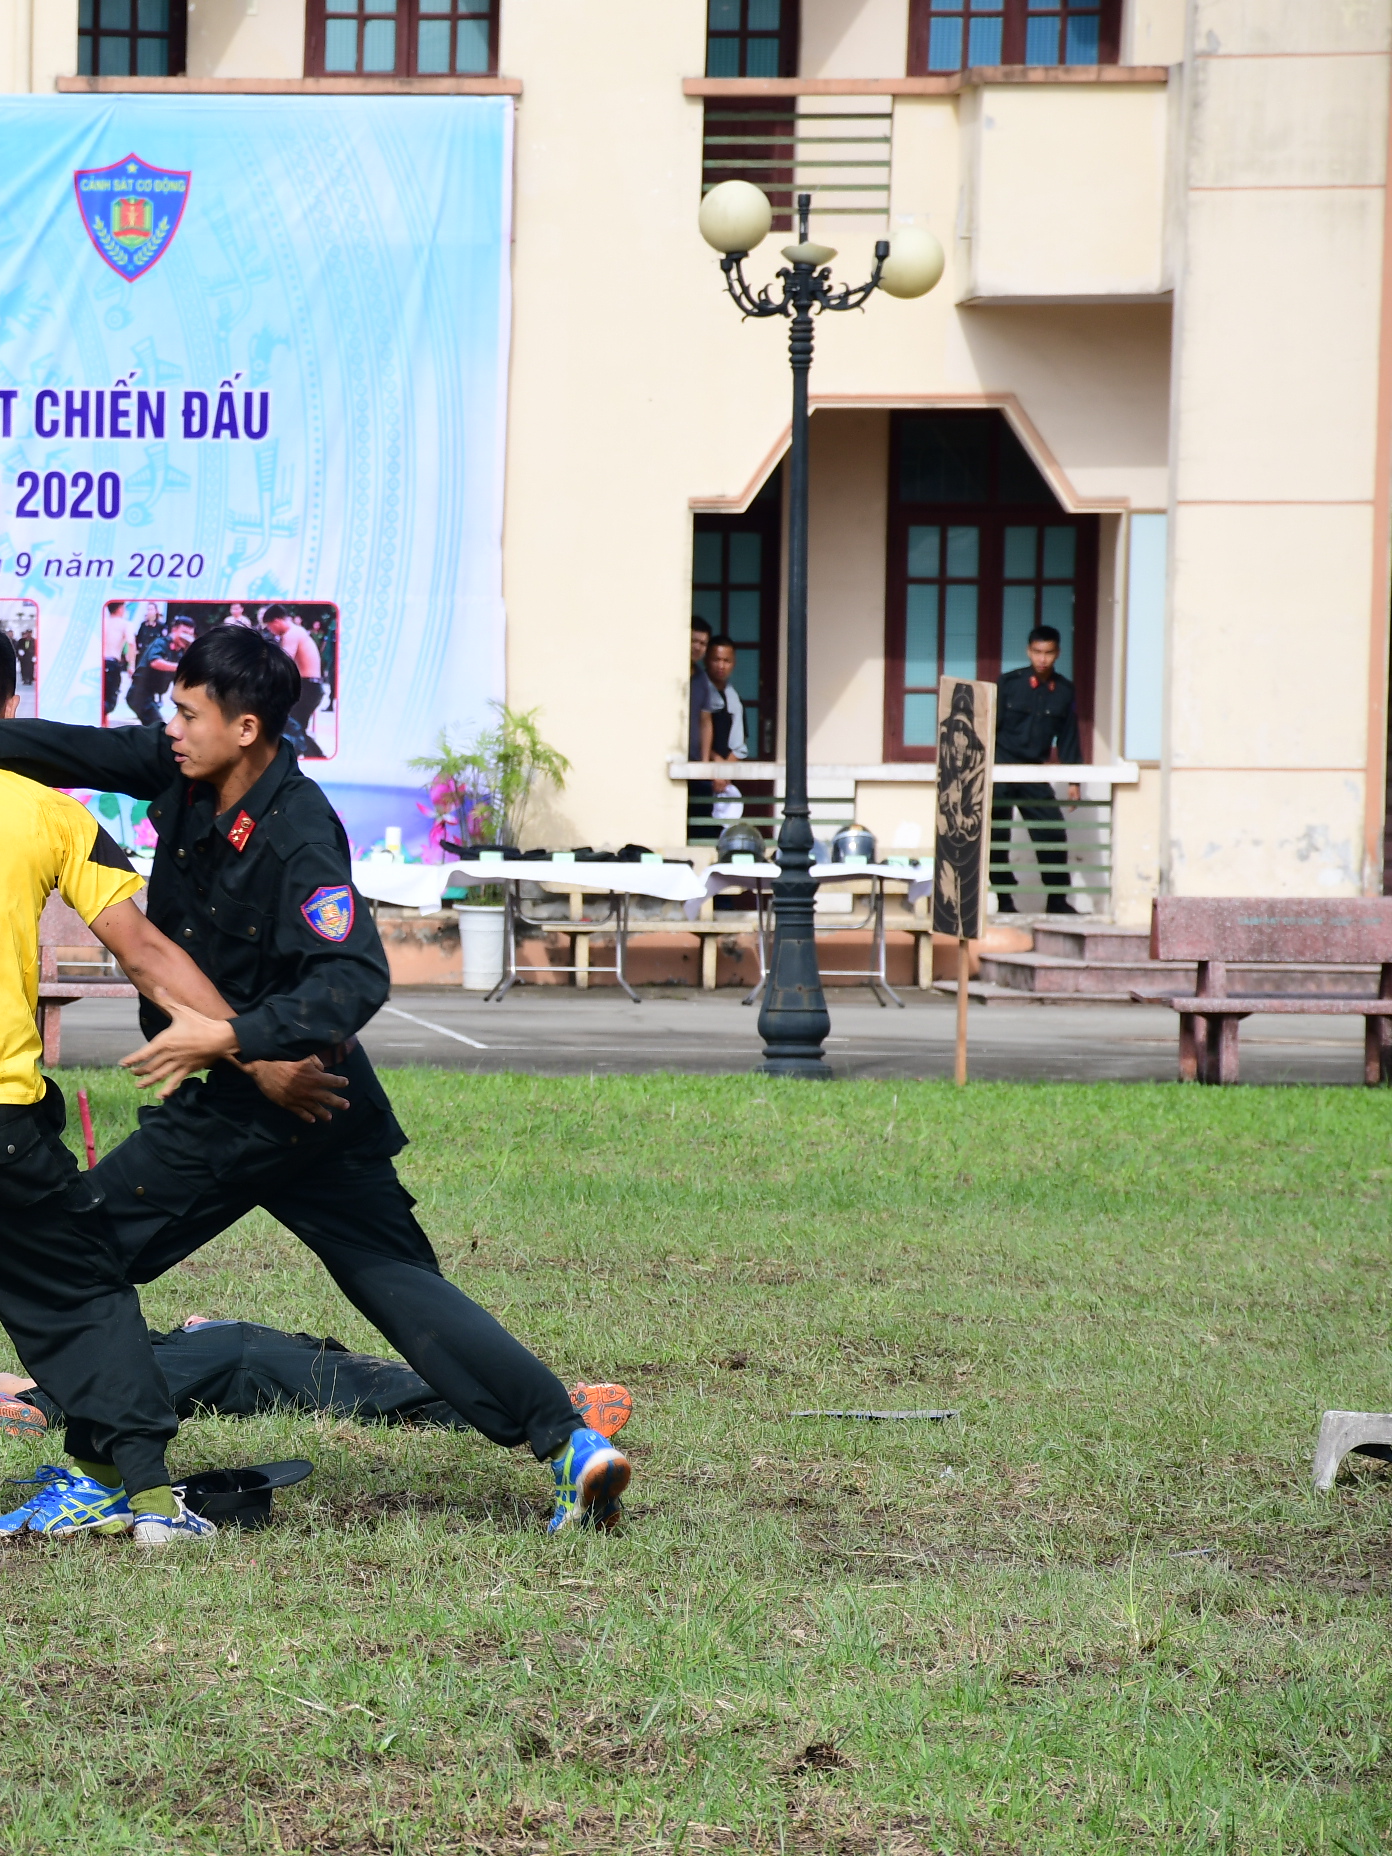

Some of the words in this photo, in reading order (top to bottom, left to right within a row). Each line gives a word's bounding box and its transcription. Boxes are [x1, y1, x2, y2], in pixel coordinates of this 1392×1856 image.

[34, 372, 166, 439] CHIẾN
[181, 372, 270, 440] ĐẤU
[14, 470, 121, 520] 2020
[14, 552, 32, 577] 9
[44, 552, 115, 578] năm
[127, 553, 205, 579] 2020
